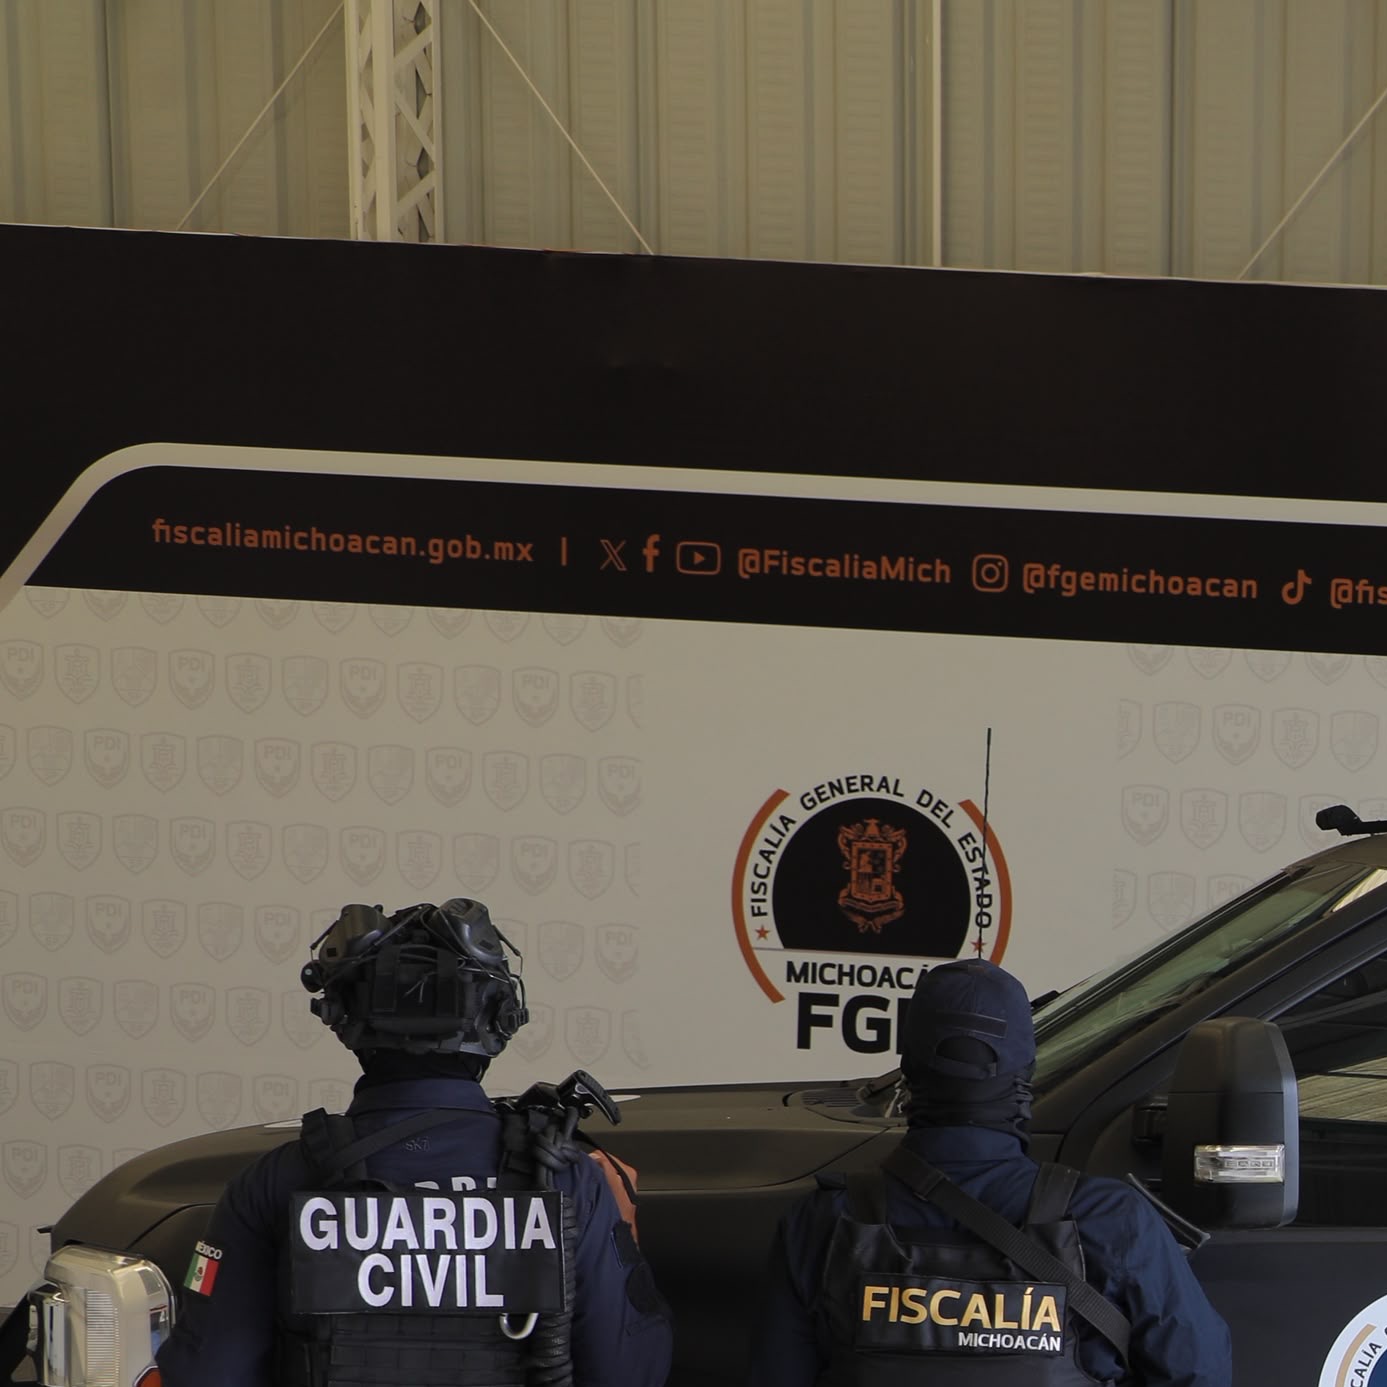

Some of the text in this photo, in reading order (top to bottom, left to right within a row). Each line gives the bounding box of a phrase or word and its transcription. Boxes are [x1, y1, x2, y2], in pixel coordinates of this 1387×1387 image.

[153, 518, 534, 563] fiscaliamichoacan.gob.mx
[737, 546, 952, 584] @FiscaliaMich
[1022, 562, 1258, 599] @fgemichoacan
[751, 775, 993, 929] FISCALÍA GENERAL DEL ESTADO
[797, 992, 914, 1055] FG
[299, 1197, 556, 1251] GUARDIA
[358, 1253, 504, 1307] CIVIL
[862, 1286, 1061, 1332] FISCALÍA
[958, 1331, 1061, 1352] MICHOACÁN
